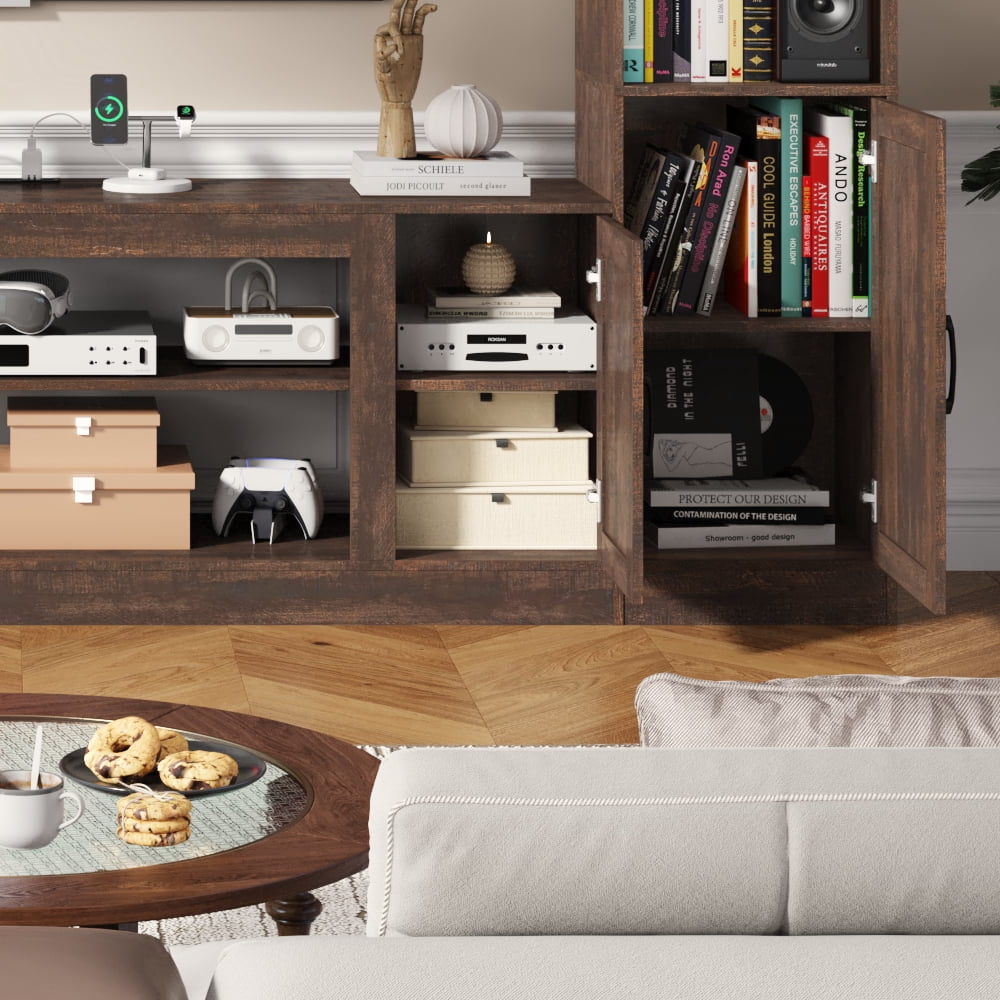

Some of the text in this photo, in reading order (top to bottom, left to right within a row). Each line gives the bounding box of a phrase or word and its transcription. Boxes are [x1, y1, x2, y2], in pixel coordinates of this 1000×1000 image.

[789, 113, 798, 173] EXECUTIVE
[719, 145, 734, 168] Ron
[418, 166, 464, 174] SCHIELE
[712, 168, 728, 197] Arad
[834, 153, 847, 202] ANDO
[387, 183, 405, 191] JODI
[856, 164, 866, 207] Research
[789, 176, 798, 226] ESCAPES
[763, 156, 775, 273] COOL GUIDE London
[817, 182, 827, 271] ANTIQUAIRES
[703, 293, 712, 312] MoMA
[684, 392, 694, 408] THE
[679, 495, 807, 504] PROTECT OUR DESIGN
[674, 511, 738, 519] CONTAMINATION
[768, 513, 797, 521] DESIGN
